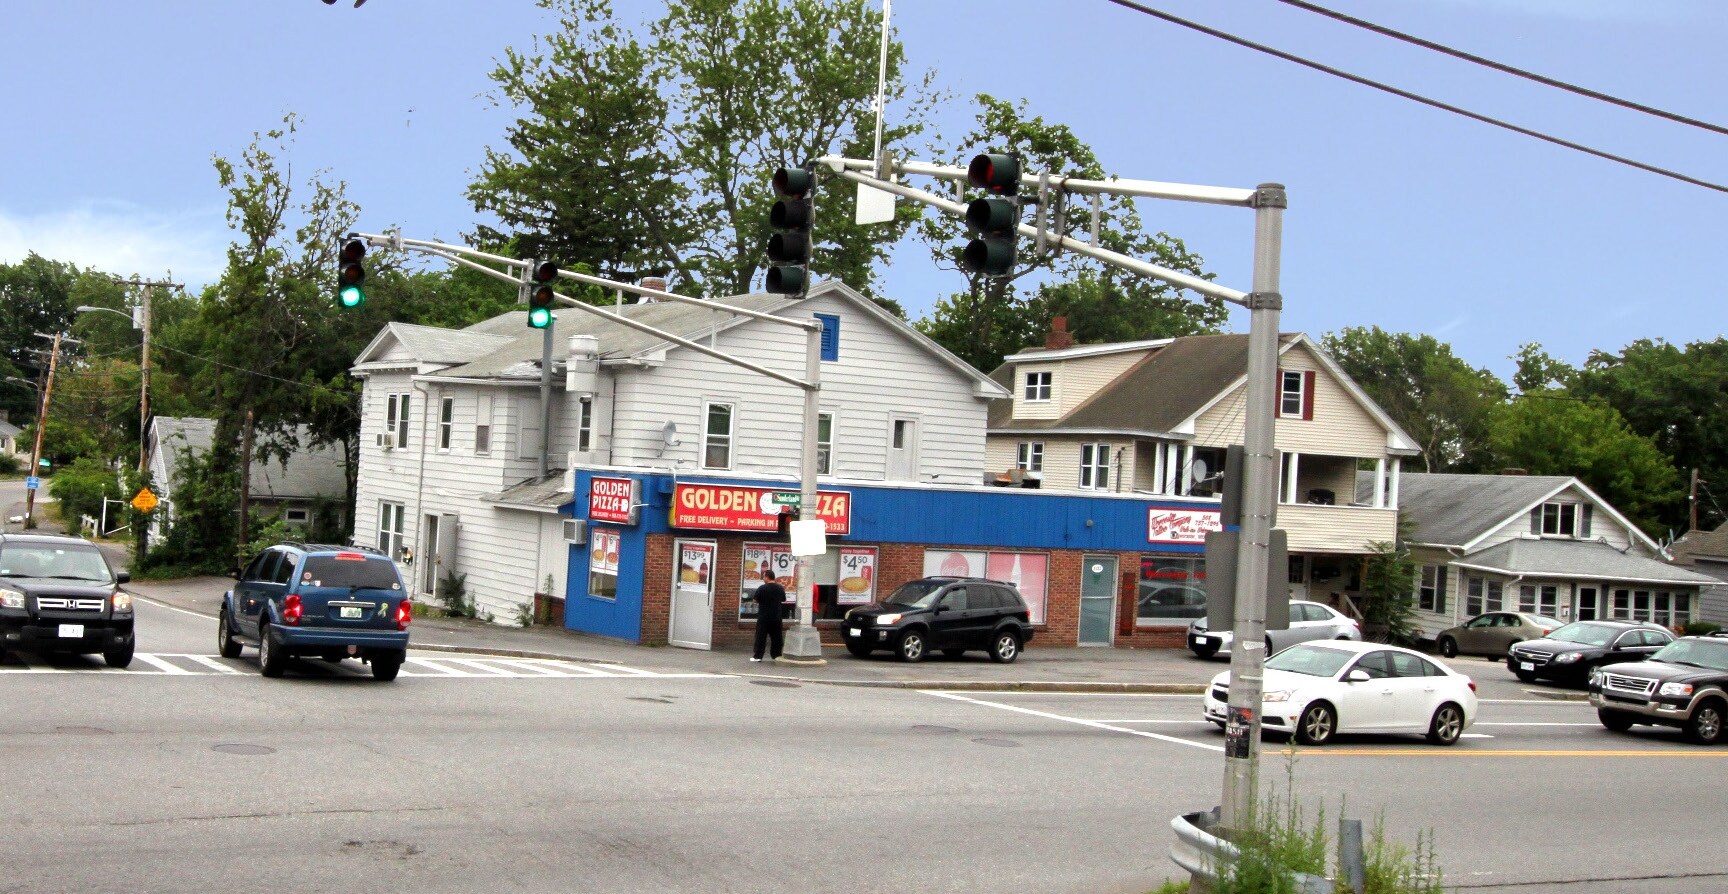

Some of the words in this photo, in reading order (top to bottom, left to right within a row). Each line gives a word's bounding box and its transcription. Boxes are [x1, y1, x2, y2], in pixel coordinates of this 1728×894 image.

[593, 481, 629, 497] GOLDEN
[592, 495, 619, 512] PIZZA
[681, 487, 757, 512] GOLDEN
[816, 495, 845, 518] ZZA
[679, 515, 696, 524] FREE
[697, 515, 728, 526] DELIVERY
[737, 519, 766, 527] PARKING
